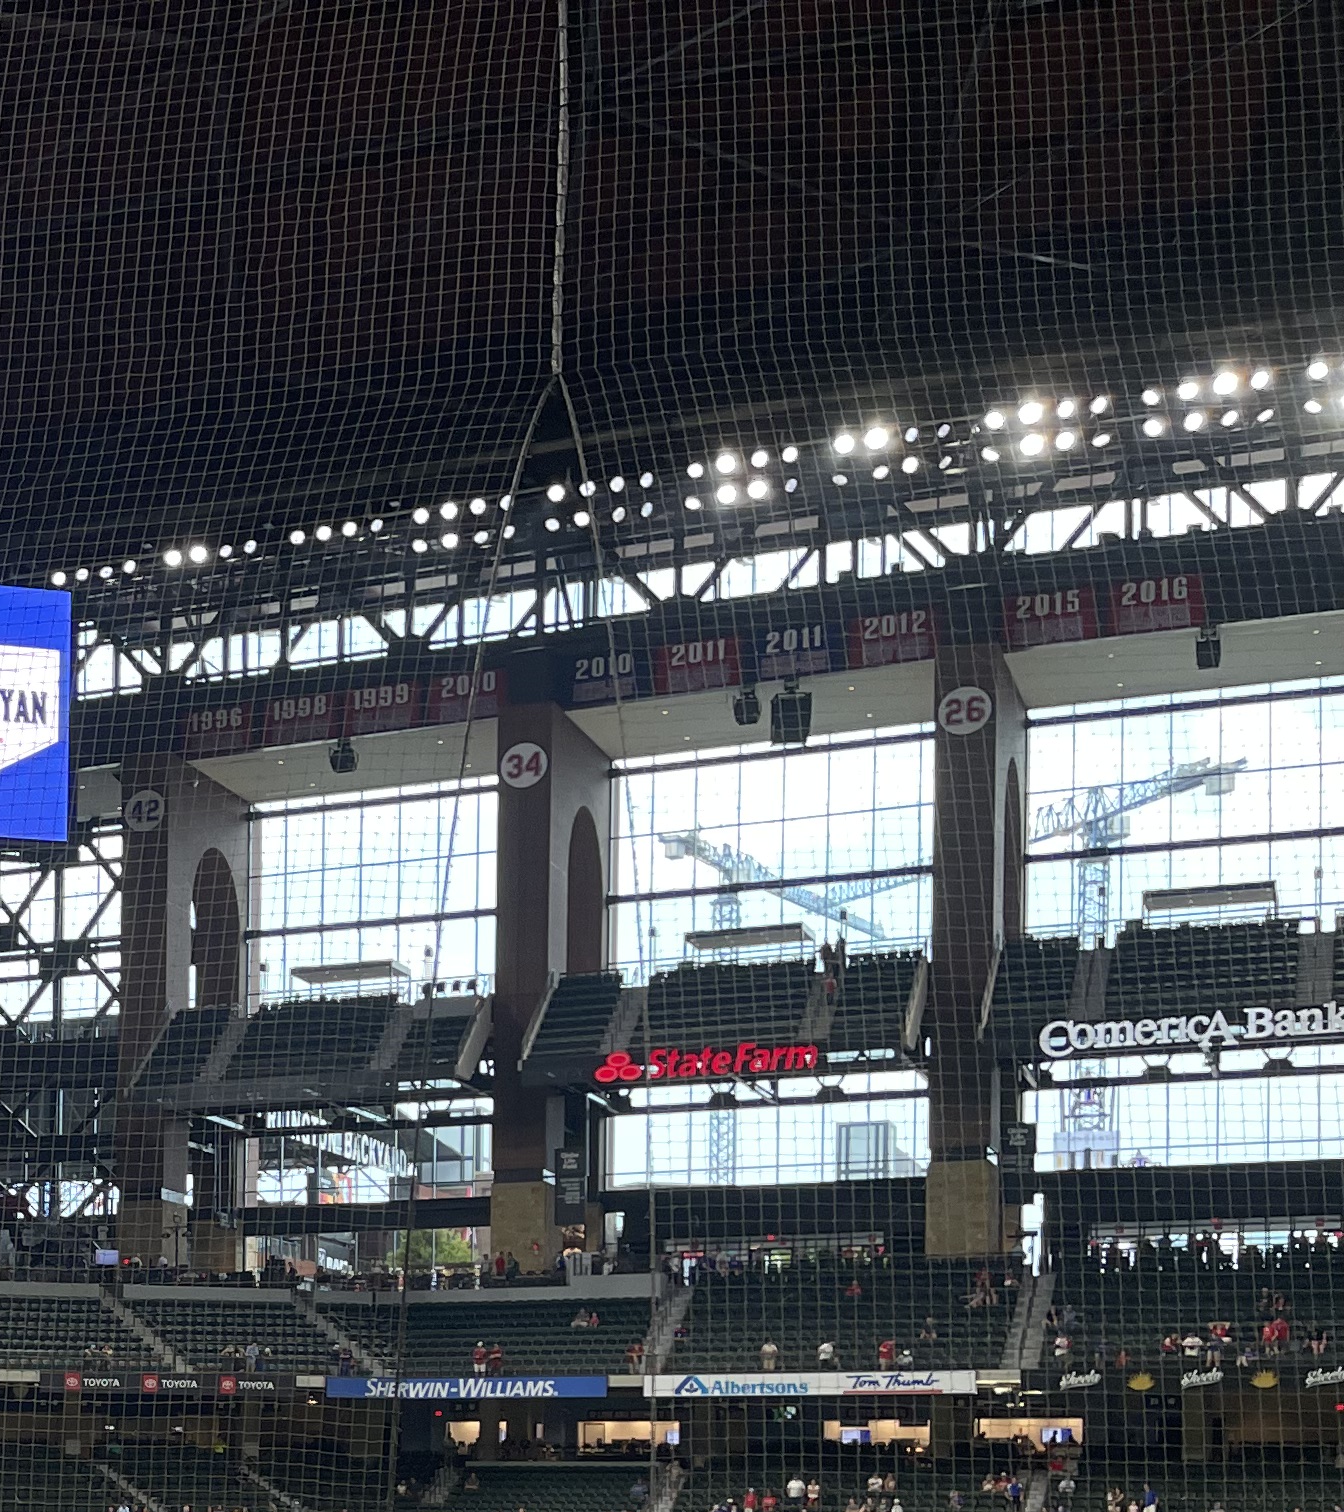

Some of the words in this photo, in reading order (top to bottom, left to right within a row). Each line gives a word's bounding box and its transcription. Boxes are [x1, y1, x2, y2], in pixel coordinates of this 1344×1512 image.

[1016, 591, 1080, 619] 2015
[1122, 577, 1188, 606] 2016
[864, 610, 926, 640] 2012
[670, 638, 725, 668] 2011
[766, 625, 822, 654] 2011
[575, 653, 632, 680] 2010
[273, 696, 327, 720] 1998
[353, 684, 409, 711] 1999
[945, 696, 986, 724] 26
[191, 708, 242, 733] 1996
[507, 752, 544, 779] 34
[130, 800, 160, 823] 42
[1243, 1001, 1344, 1039] Bank
[82, 1378, 120, 1388] TOYOTA
[161, 1379, 197, 1389] TOYOTA
[238, 1380, 274, 1391] TOYOTA
[712, 1379, 808, 1395] Albertsons
[847, 1374, 880, 1389] Tom
[882, 1372, 939, 1389] Thumb
